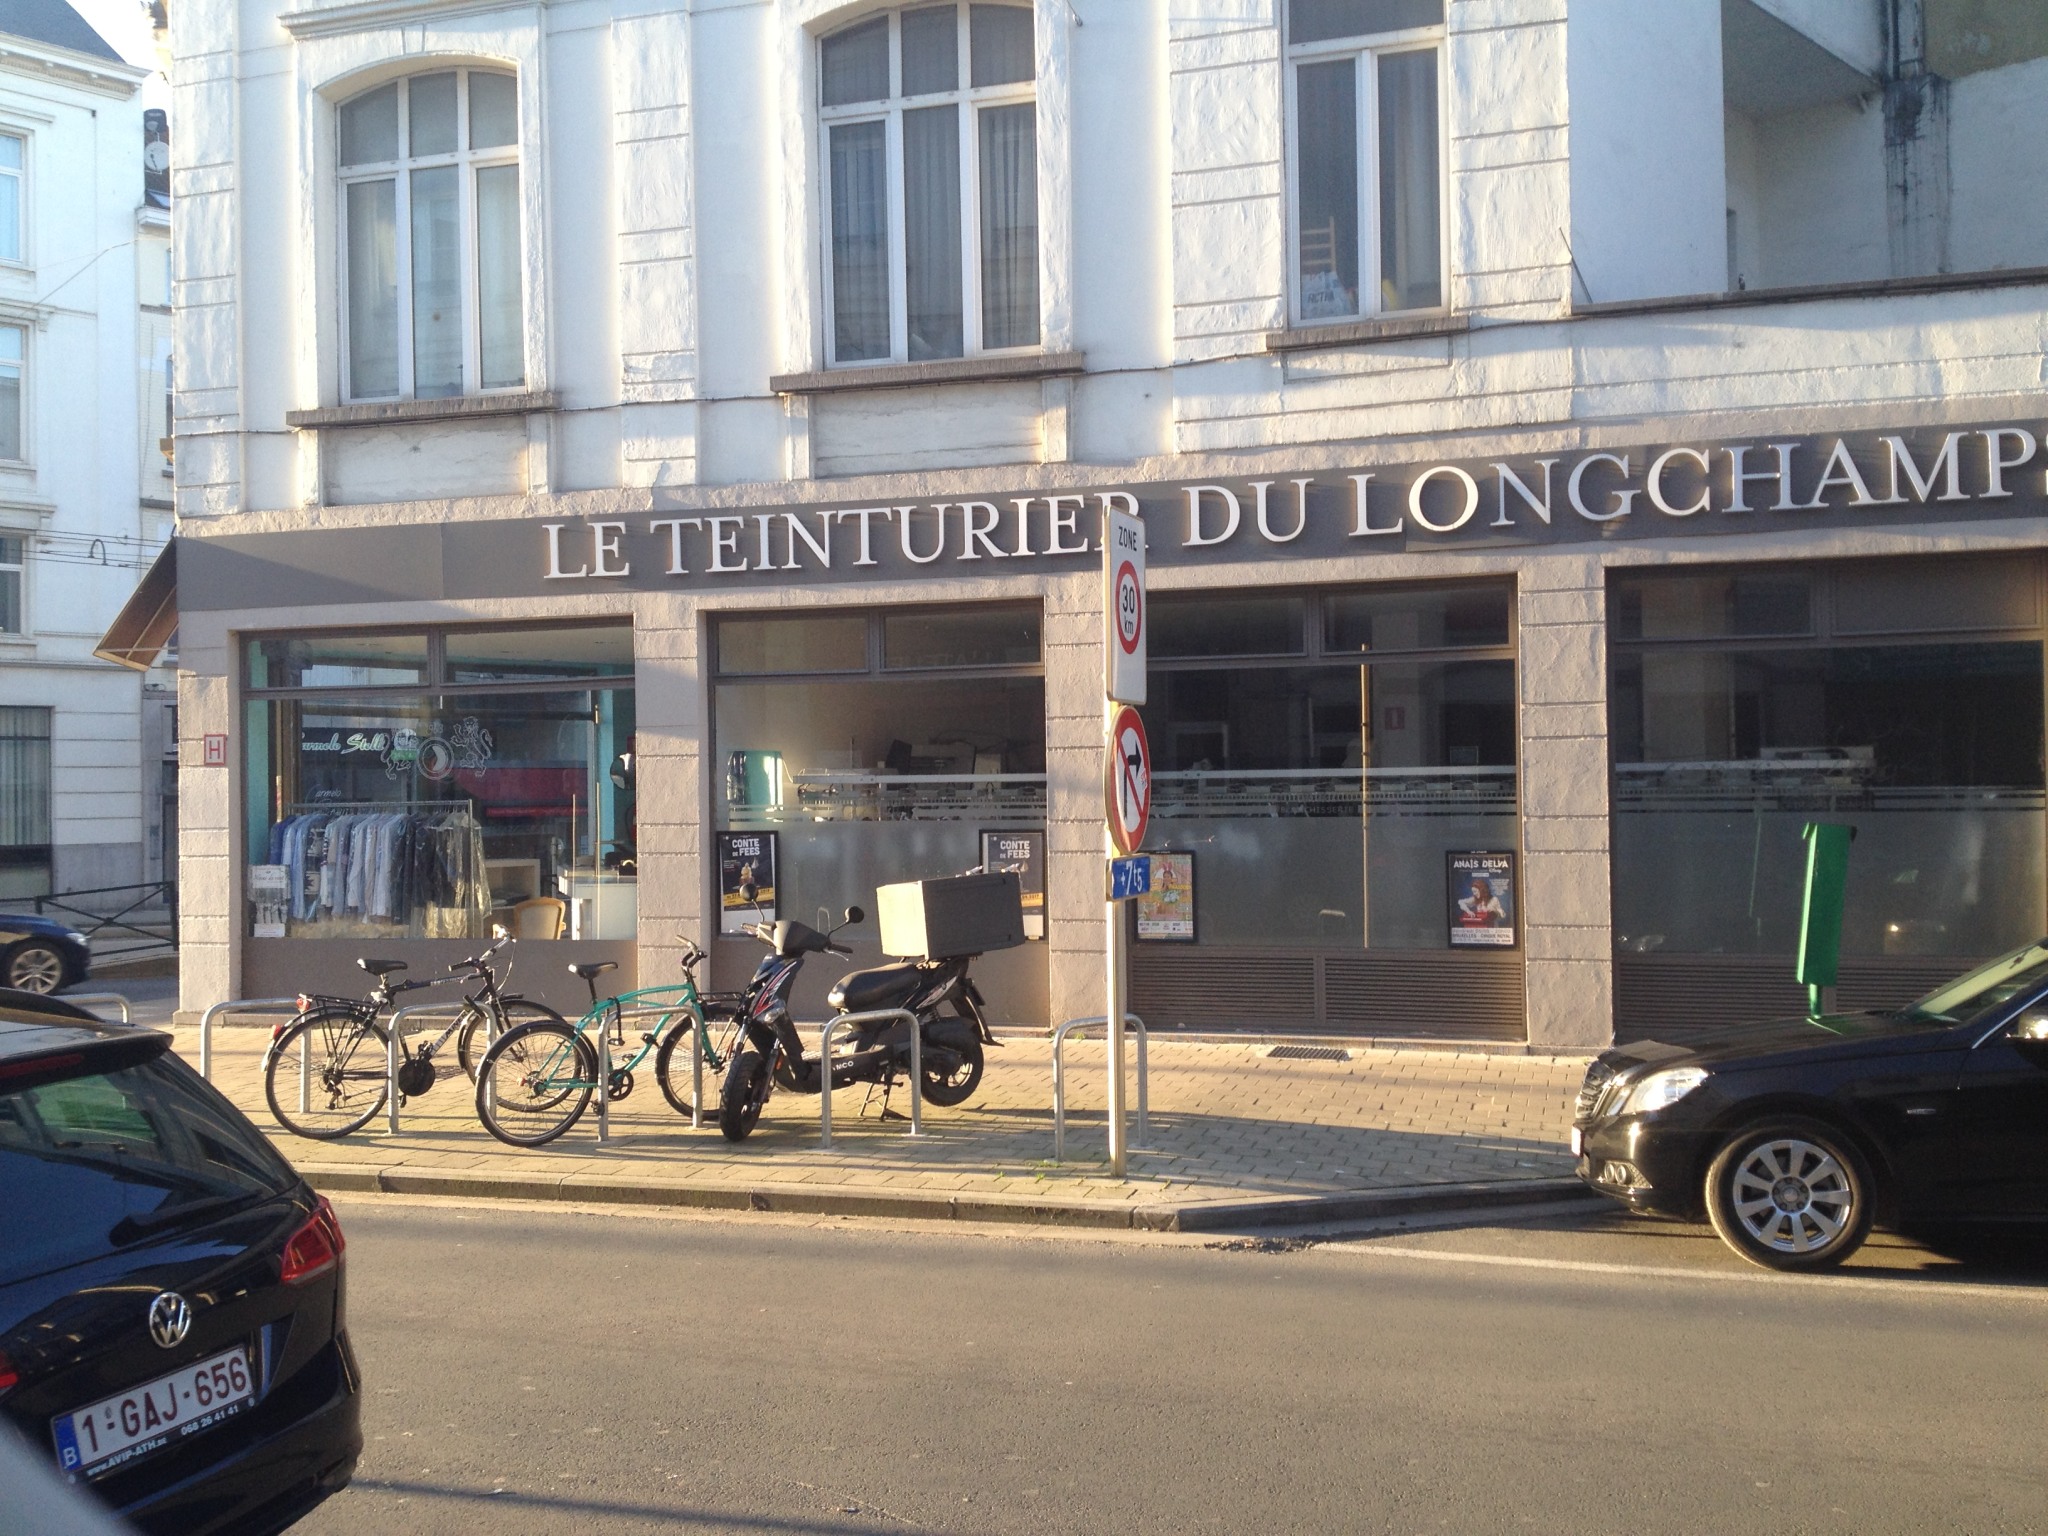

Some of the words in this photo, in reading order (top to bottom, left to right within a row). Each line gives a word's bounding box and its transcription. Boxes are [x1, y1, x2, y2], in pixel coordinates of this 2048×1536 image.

[542, 521, 630, 579] LE
[1181, 477, 1315, 547] DU
[1347, 427, 2048, 537] LONGCHAMP
[1118, 525, 1137, 552] ZONE
[1122, 583, 1136, 615] 30
[1124, 616, 1134, 635] km
[209, 740, 221, 760] H
[302, 732, 342, 751] armelo
[731, 838, 760, 849] CONTE
[739, 846, 761, 857] FEES
[1000, 840, 1030, 850] CONTE
[1007, 849, 1031, 859] FEES
[1481, 858, 1509, 869] DELVA
[833, 1060, 854, 1071] MCO
[62, 1446, 78, 1469] B
